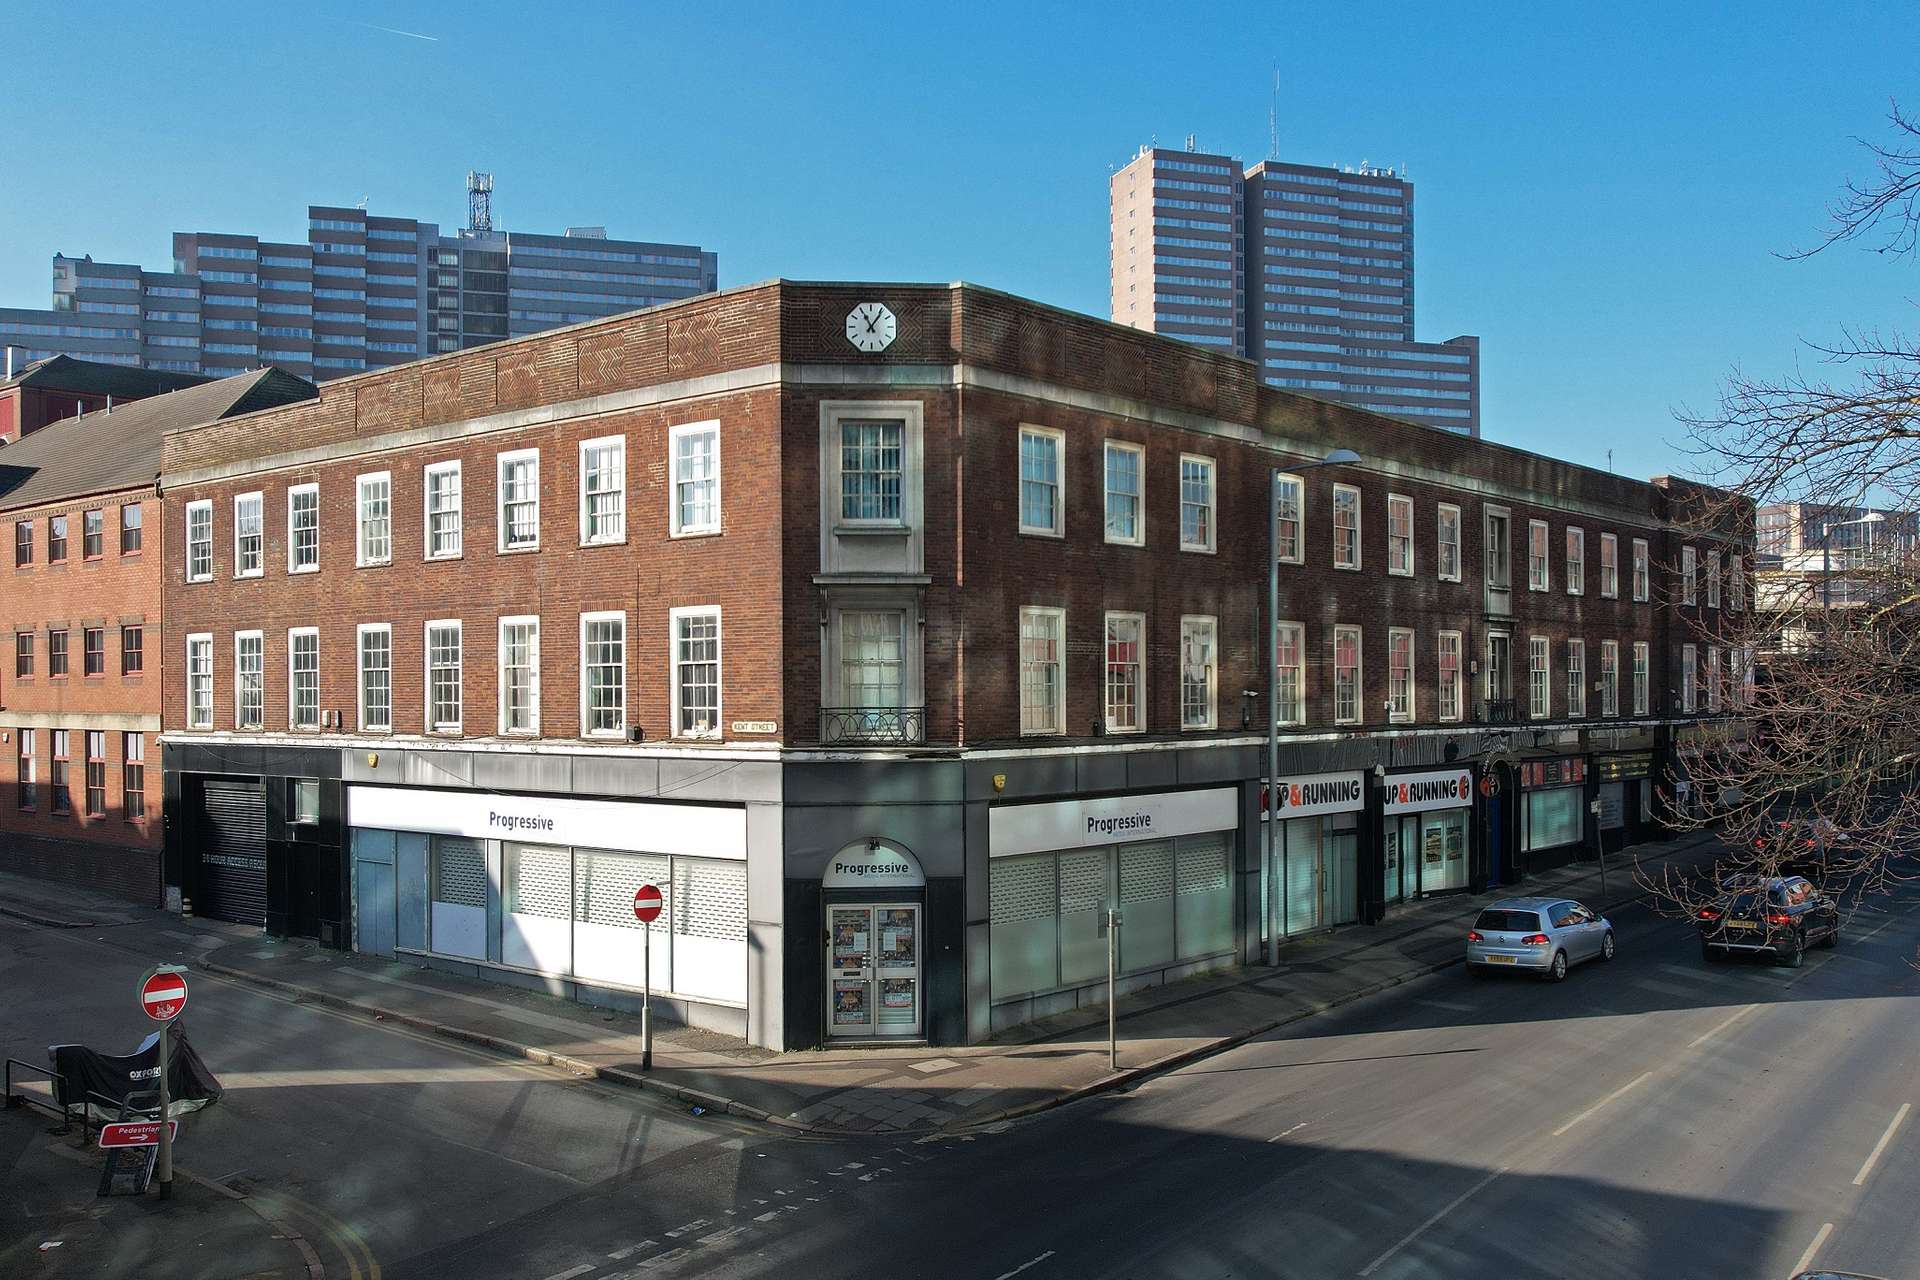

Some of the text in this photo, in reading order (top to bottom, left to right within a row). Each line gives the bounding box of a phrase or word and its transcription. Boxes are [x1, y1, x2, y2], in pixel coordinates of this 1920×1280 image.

[734, 723, 774, 731] KENT STREET
[489, 811, 554, 831] Progressive
[1087, 812, 1152, 834] Progressive
[835, 862, 909, 876] Progressive
[129, 1065, 162, 1079] OXFOR
